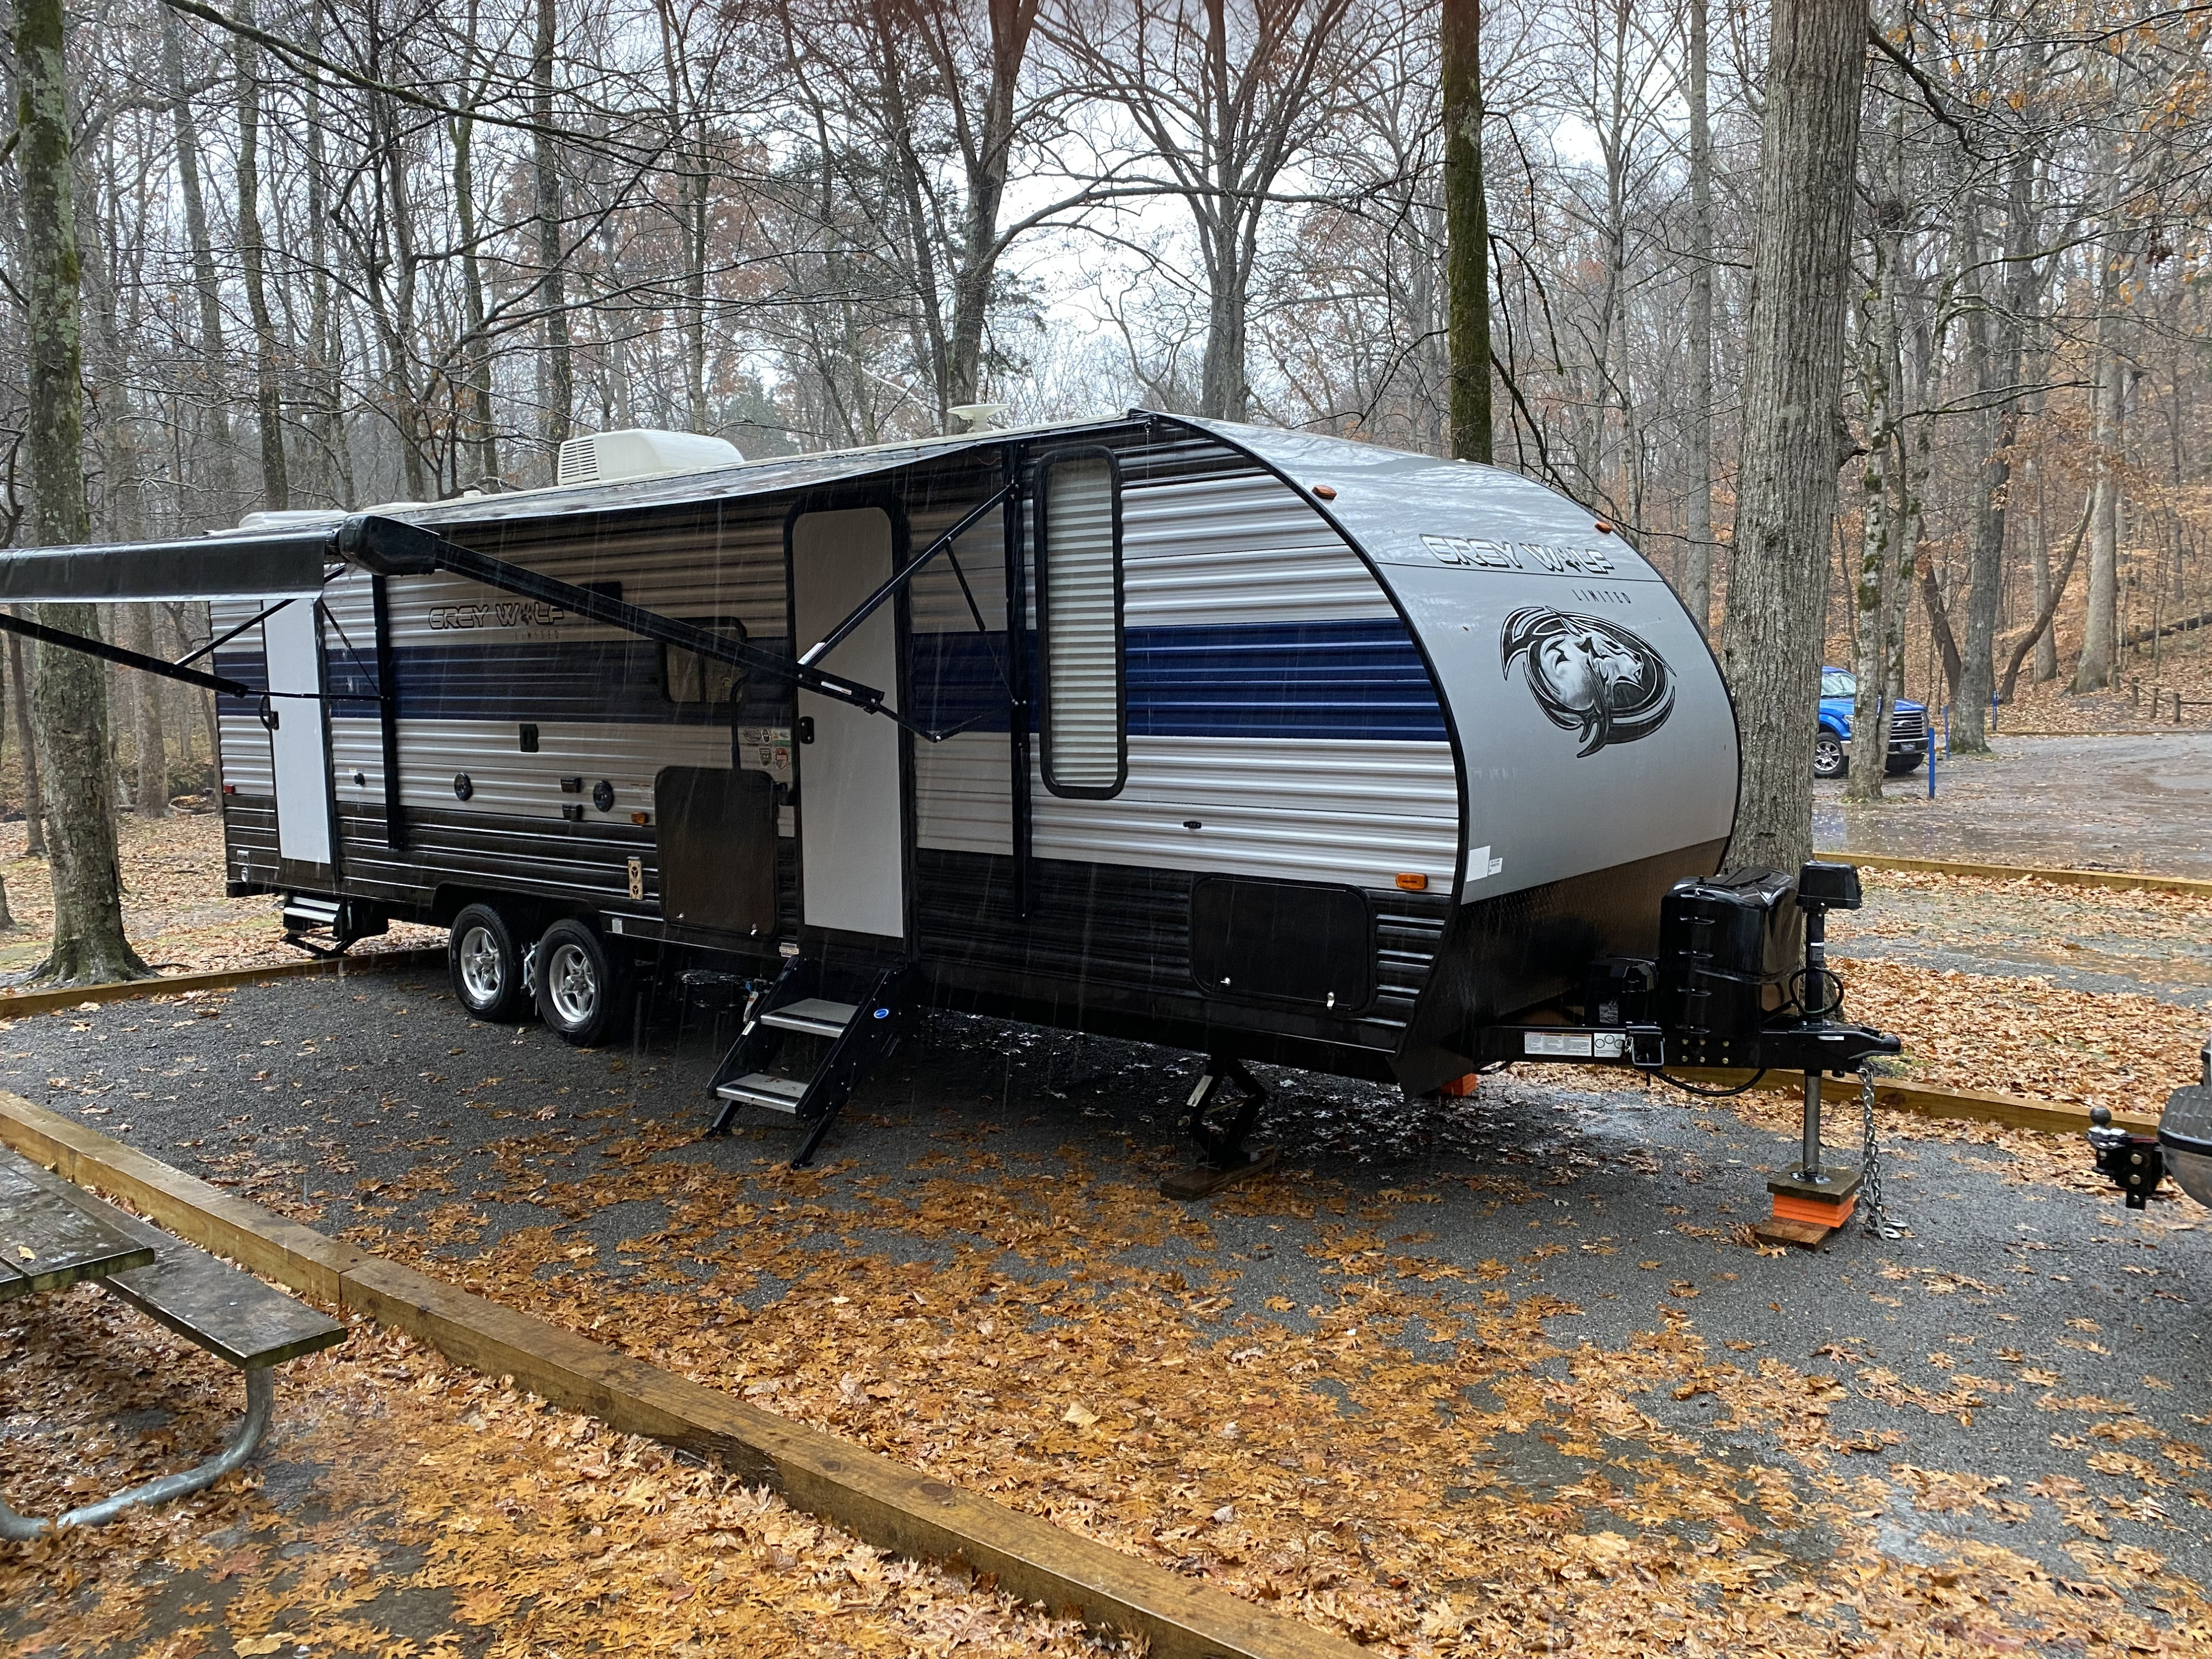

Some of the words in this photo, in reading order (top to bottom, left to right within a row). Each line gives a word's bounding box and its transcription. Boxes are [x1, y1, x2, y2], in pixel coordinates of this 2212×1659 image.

[1419, 534, 1523, 569] GREY
[1572, 589, 1631, 603] LIMITED
[429, 604, 488, 629] GREY
